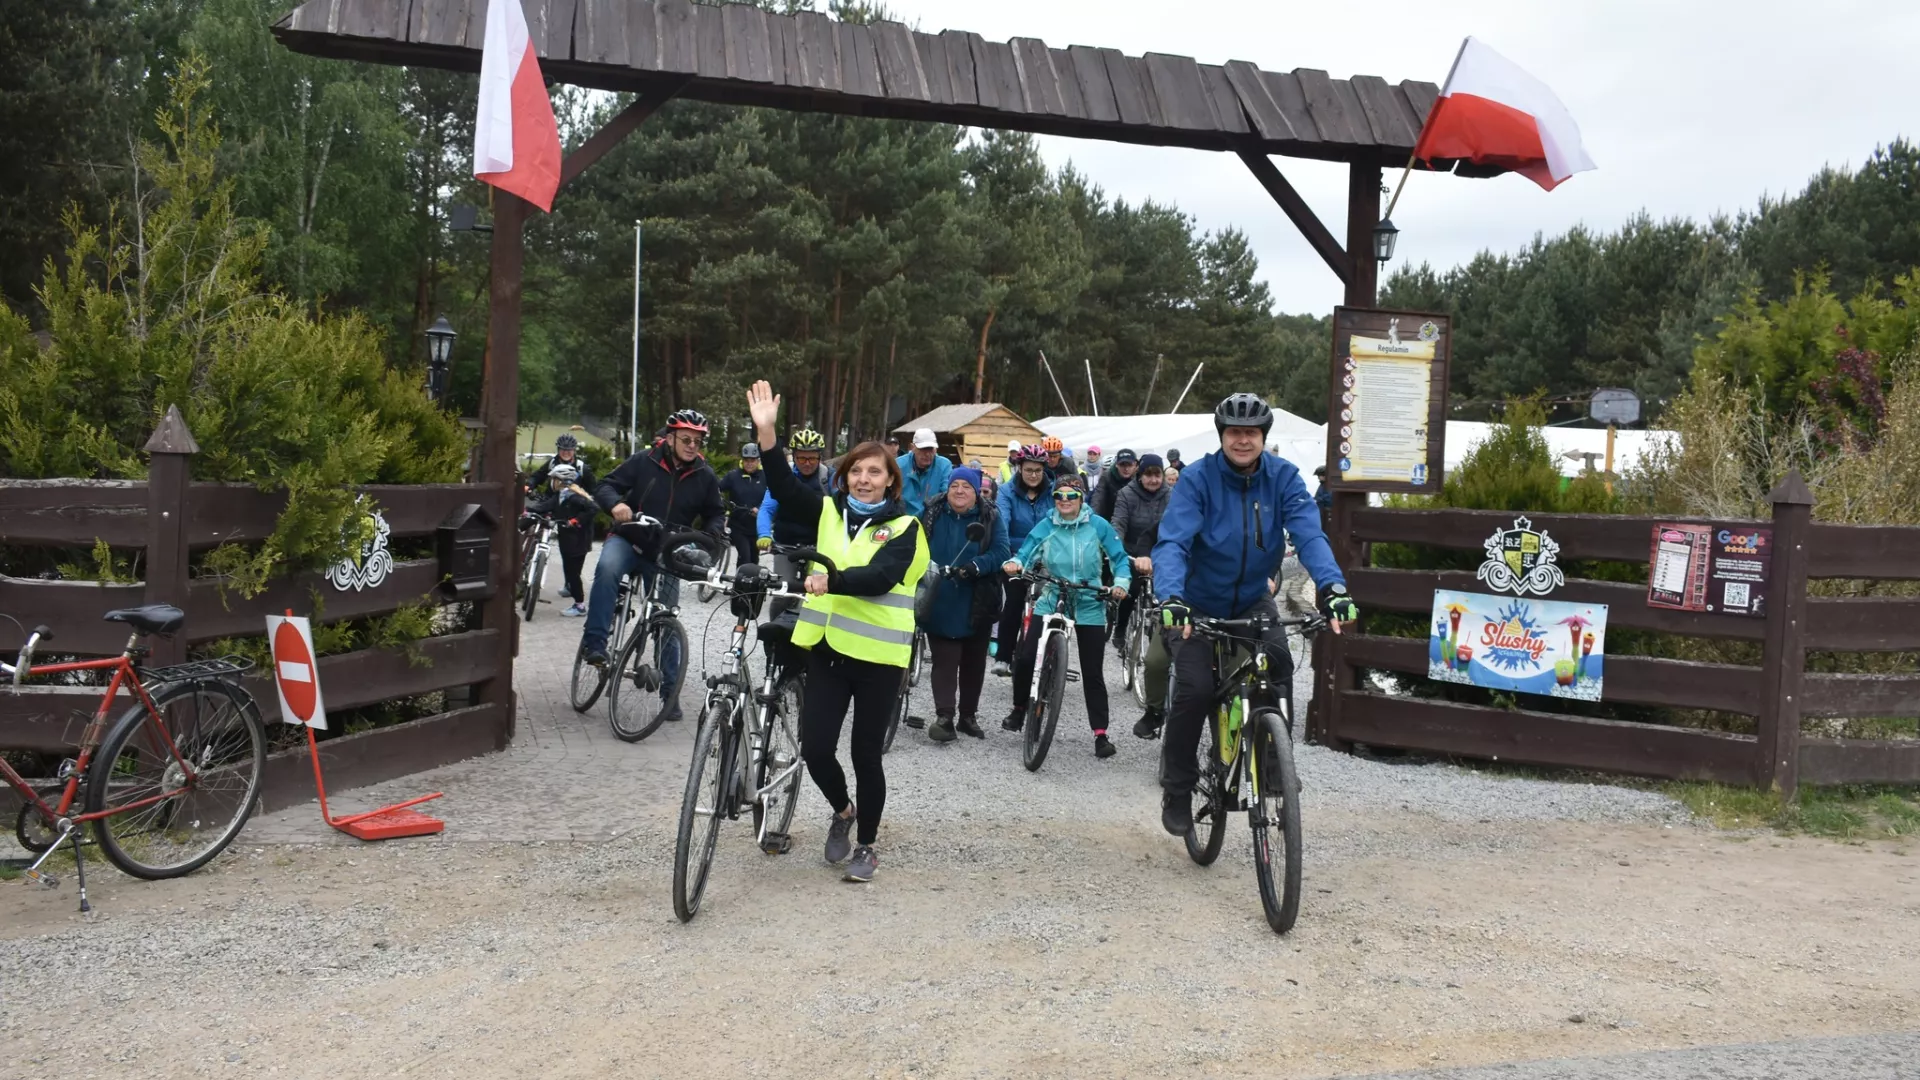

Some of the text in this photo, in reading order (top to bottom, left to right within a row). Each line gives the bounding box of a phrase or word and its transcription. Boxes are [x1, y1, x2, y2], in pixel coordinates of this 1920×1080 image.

[1377, 344, 1409, 354] Regulamin
[1717, 529, 1766, 549] Google
[1480, 622, 1546, 660] Slushy
